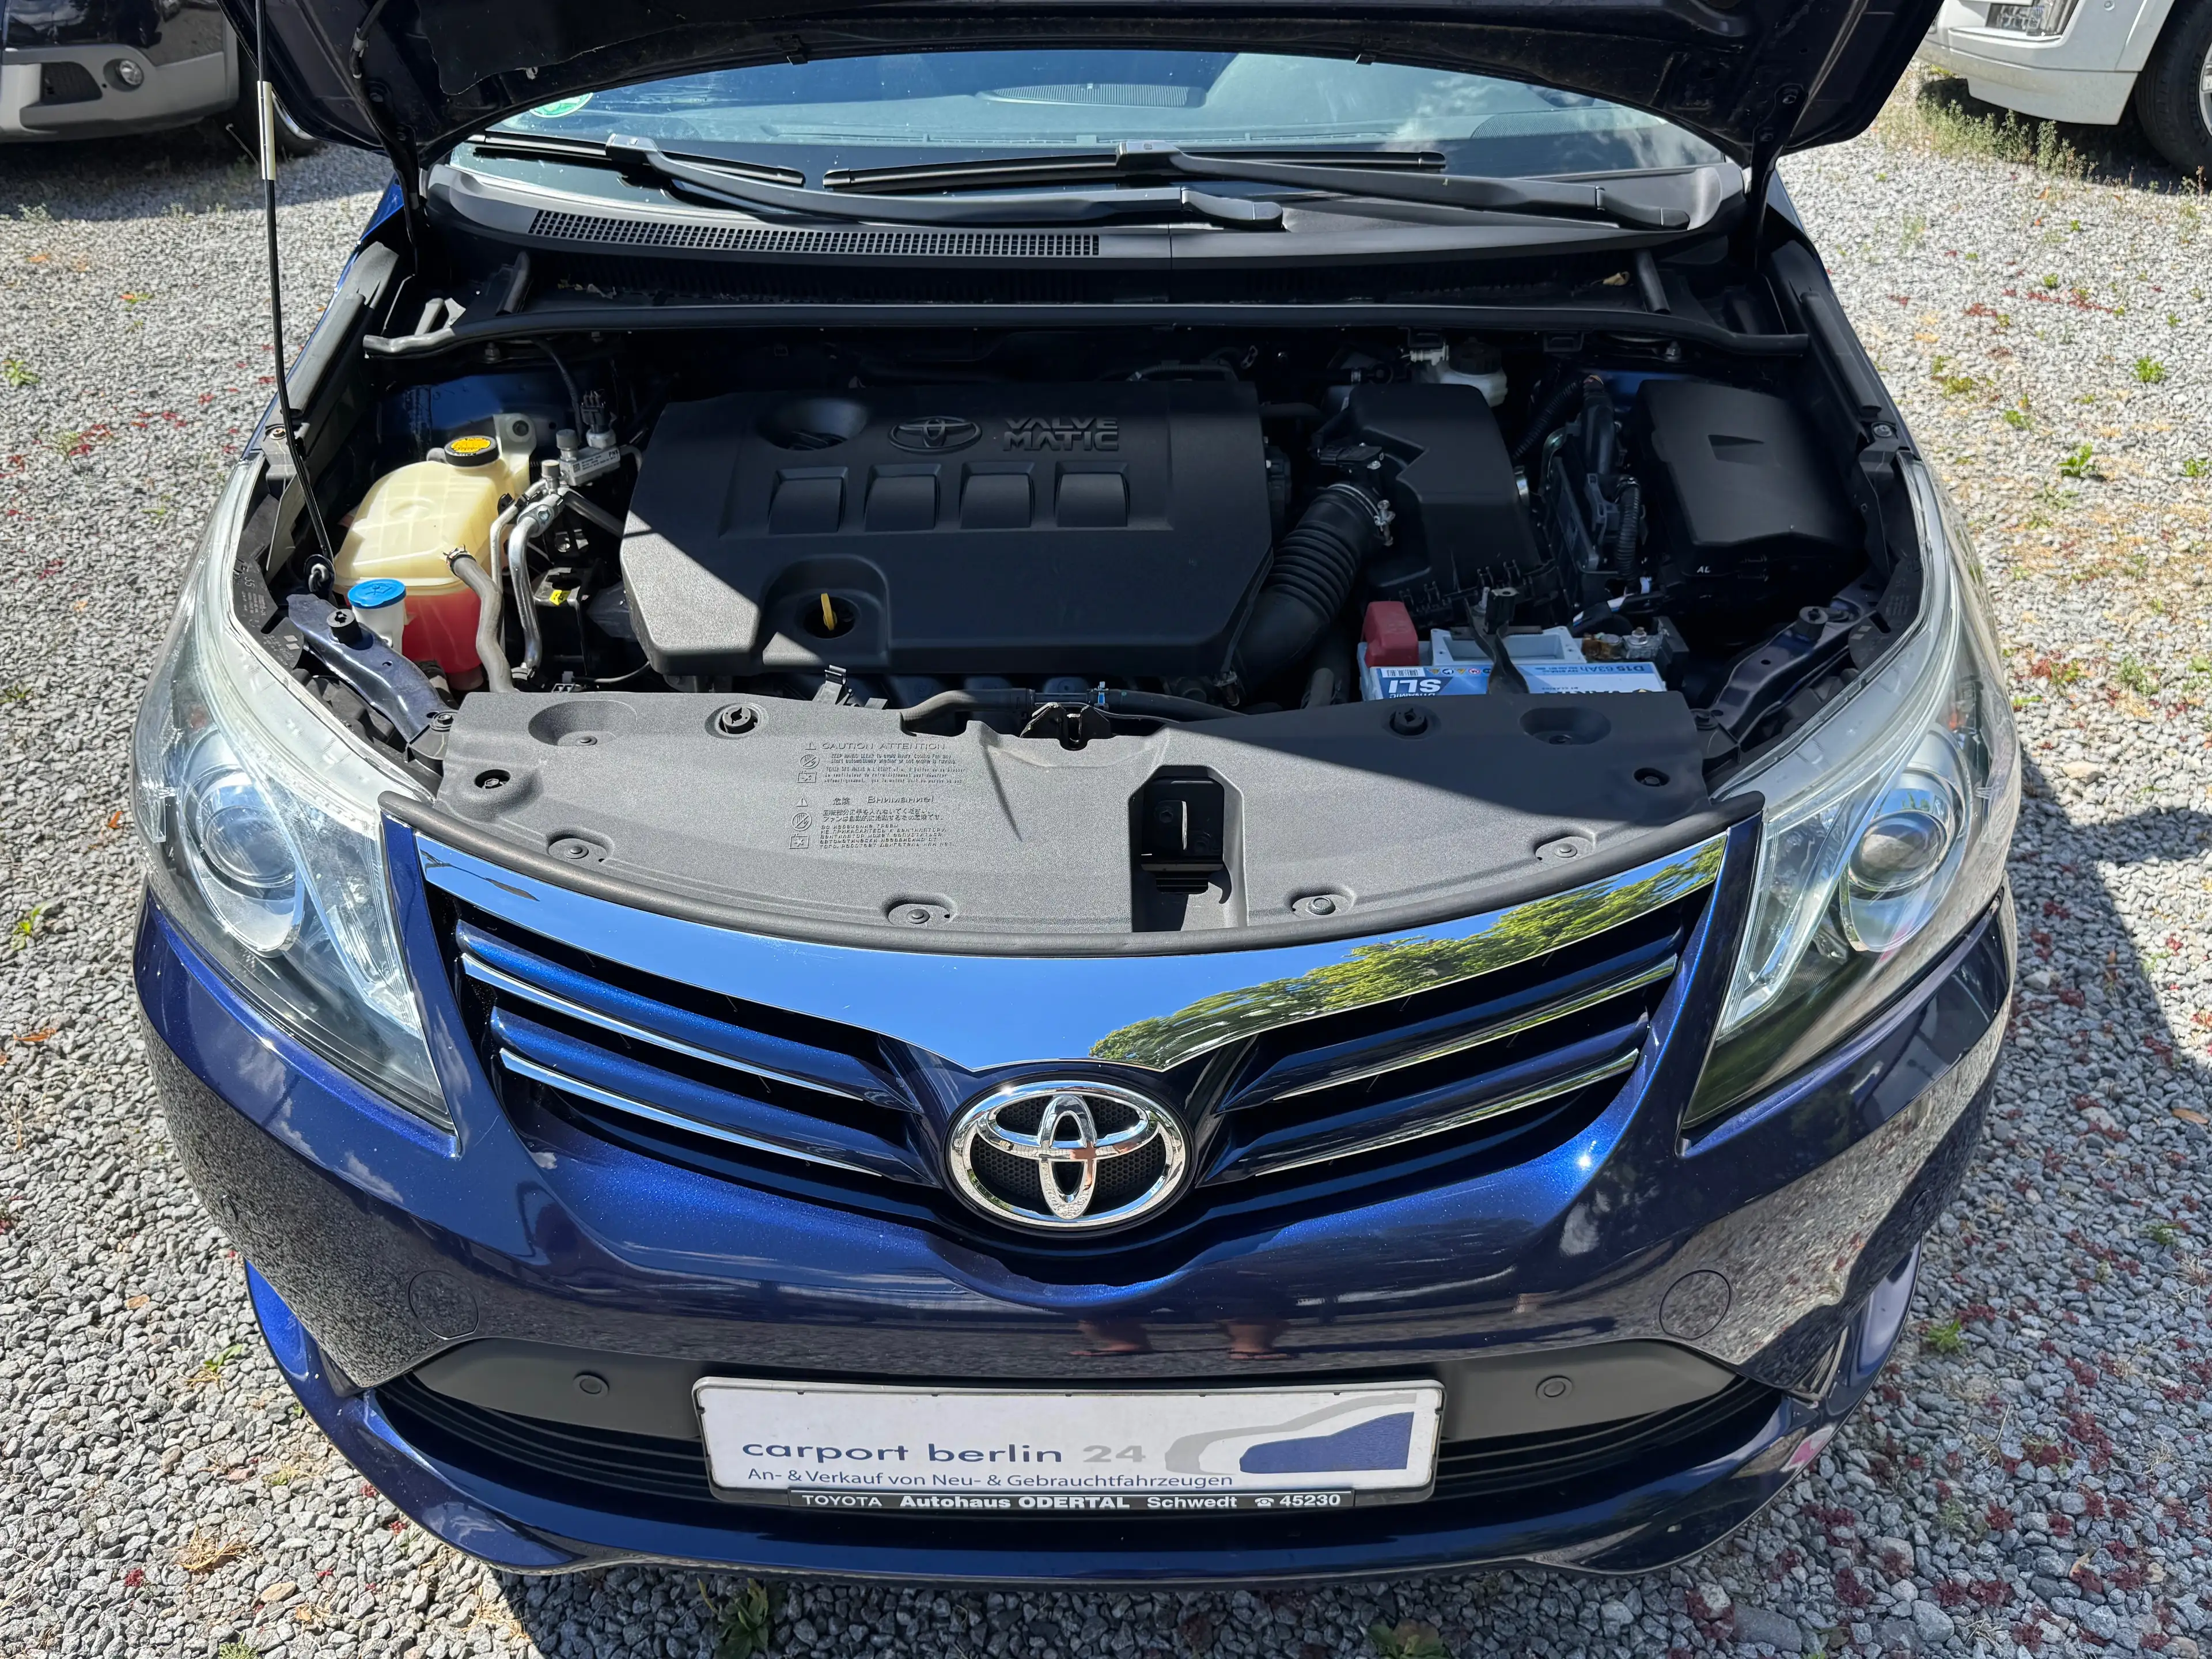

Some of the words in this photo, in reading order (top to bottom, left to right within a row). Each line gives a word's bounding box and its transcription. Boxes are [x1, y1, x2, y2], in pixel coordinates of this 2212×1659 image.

[1003, 416, 1119, 430] VALVE
[1002, 430, 1120, 452] MATIC
[1388, 679, 1441, 694] SLI
[742, 1442, 910, 1463] carport
[927, 1443, 1062, 1463] berlin
[1082, 1444, 1146, 1463] 24
[748, 1468, 783, 1481] An-
[787, 1469, 802, 1482] &
[805, 1470, 884, 1484] Verkauf
[888, 1474, 926, 1485] von
[933, 1474, 982, 1486] Neu-
[987, 1475, 1002, 1487] &
[1007, 1474, 1233, 1489] Gebrauchtfahrzeugen
[801, 1494, 882, 1508] TOYOTA
[899, 1495, 1012, 1509] Autohaus
[1018, 1495, 1130, 1509] ODERTAL
[1147, 1495, 1237, 1509] Schwedt
[1278, 1494, 1341, 1507] 45230
